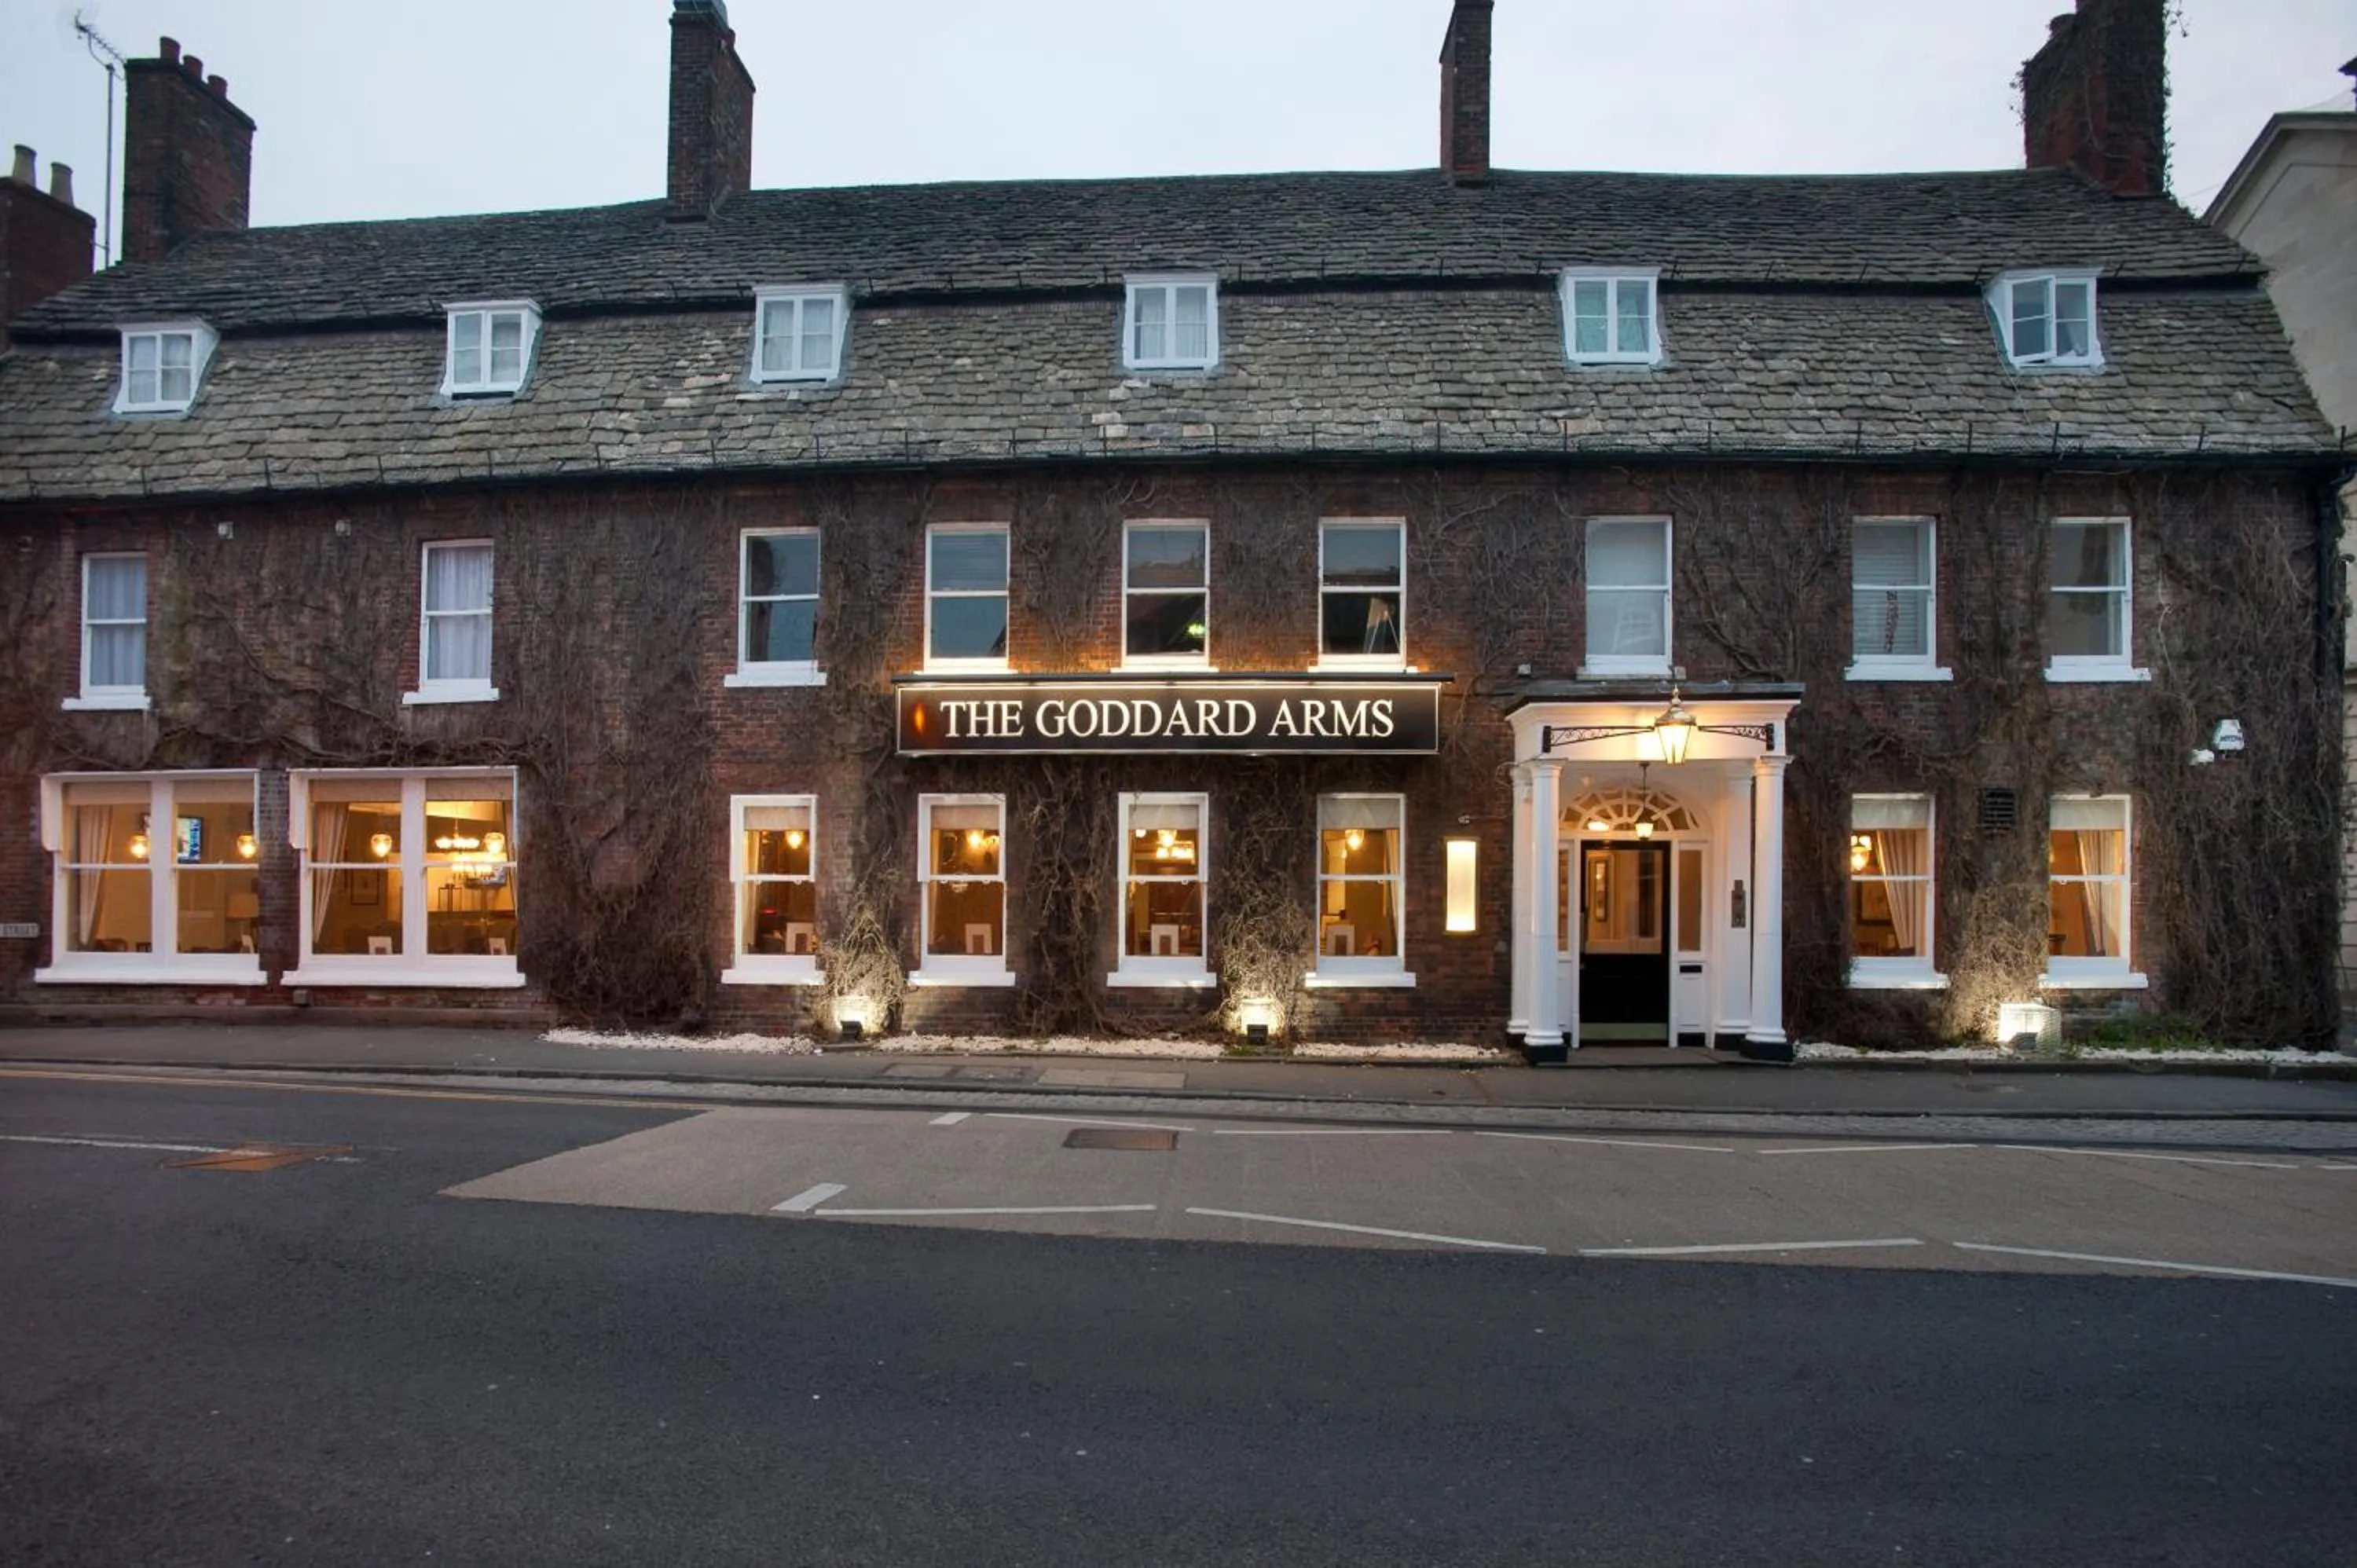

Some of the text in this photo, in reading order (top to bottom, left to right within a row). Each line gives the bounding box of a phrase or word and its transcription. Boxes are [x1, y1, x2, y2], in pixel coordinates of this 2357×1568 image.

[940, 698, 1395, 737] THE GODDARD ARMS
